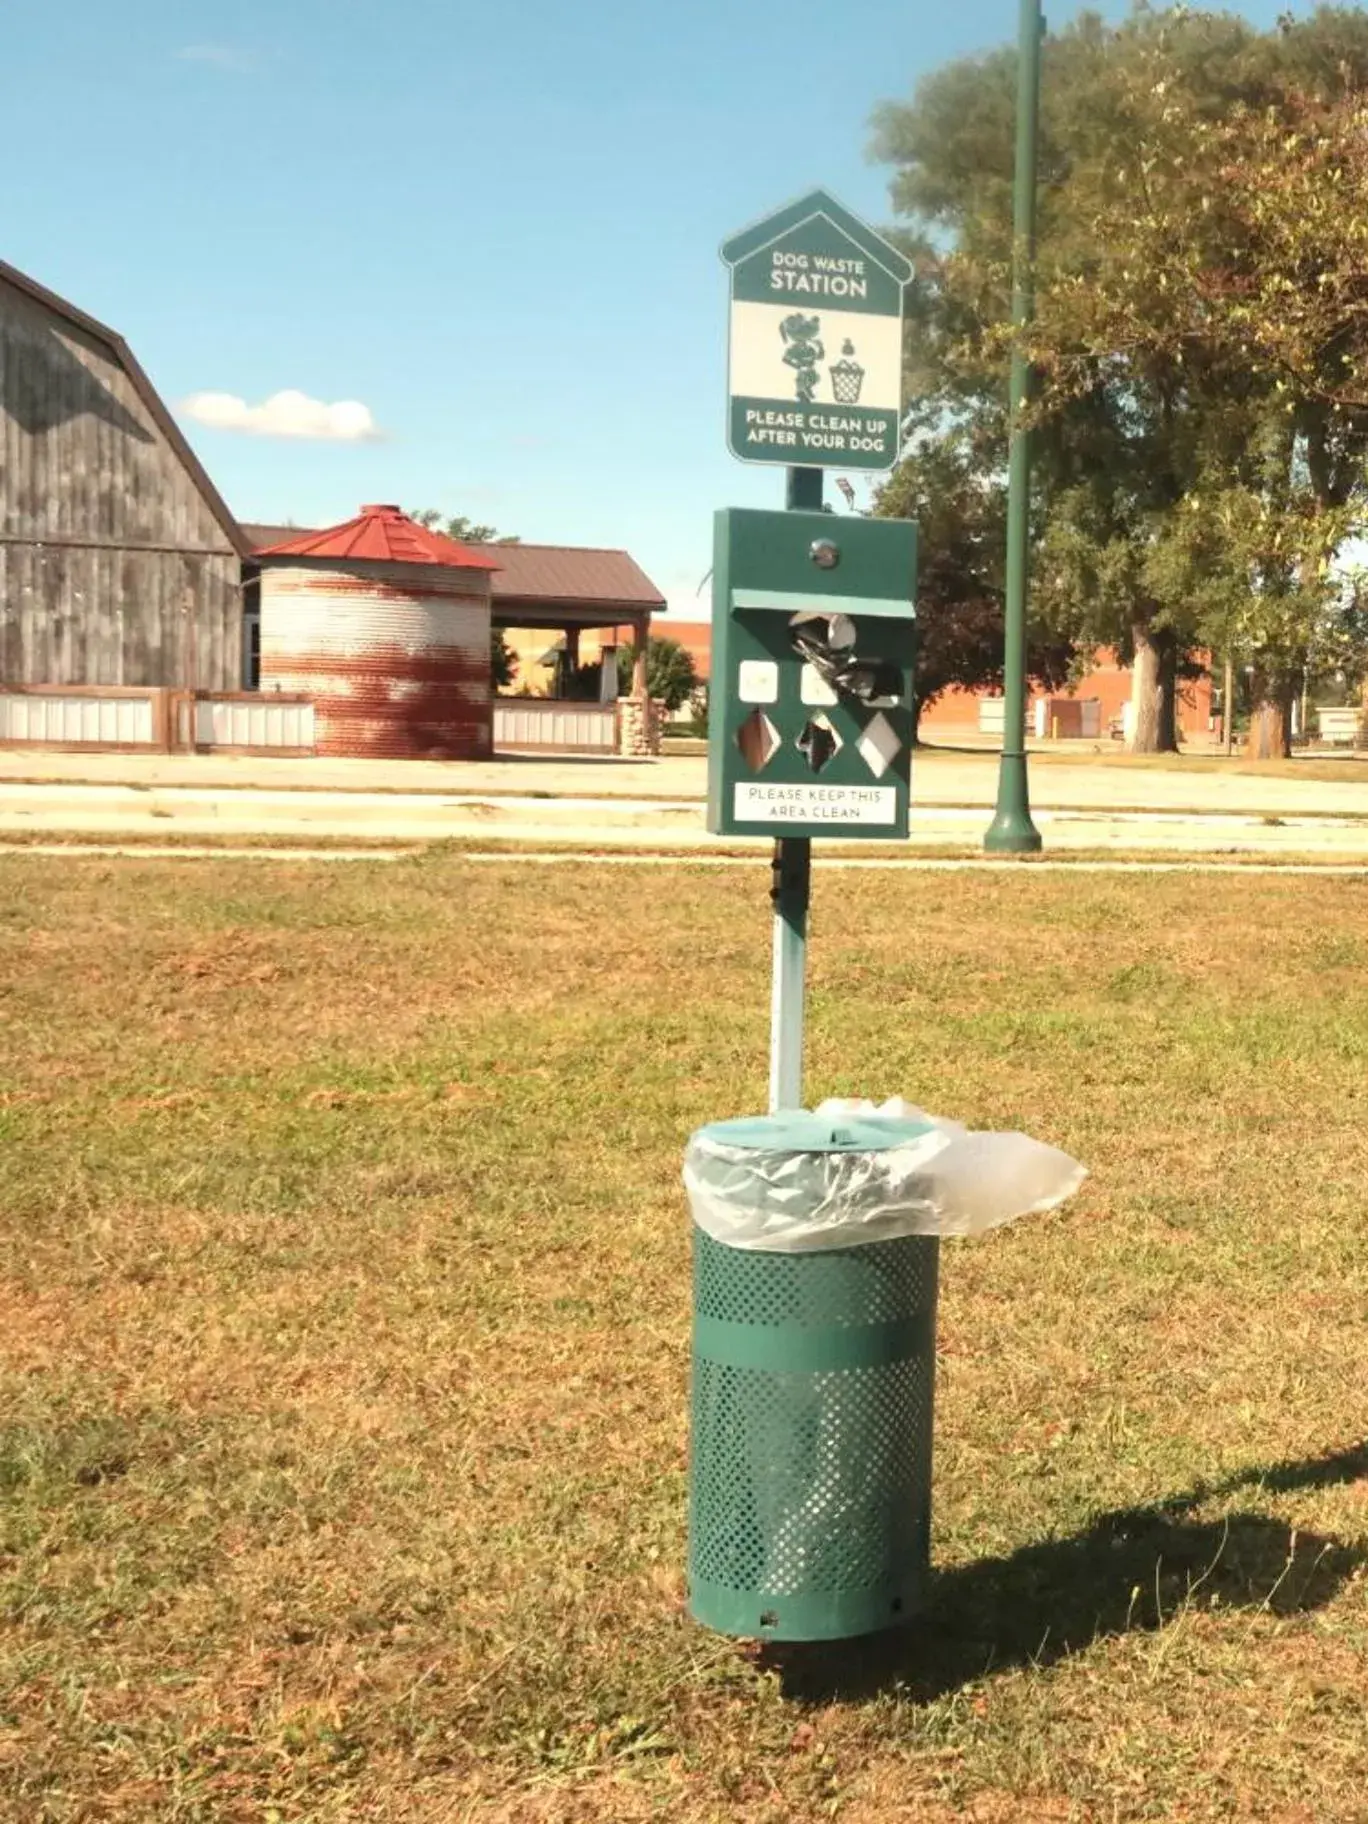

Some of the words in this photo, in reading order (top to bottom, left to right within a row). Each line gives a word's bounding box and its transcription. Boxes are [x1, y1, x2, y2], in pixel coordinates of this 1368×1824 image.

[773, 251, 809, 268] DOG
[814, 258, 865, 274] WASTE
[771, 271, 867, 298] STATION
[746, 410, 804, 428] PLEASE
[810, 415, 861, 432] CLEAN
[866, 419, 887, 434] UP
[747, 429, 797, 446] AFTER
[801, 432, 845, 449] YOUR
[850, 436, 885, 452] DOG
[749, 788, 802, 801] PLEASE
[809, 789, 845, 802] KEEP
[850, 790, 881, 803] THIS
[769, 805, 807, 818] AREA
[813, 806, 860, 819] CLEAN
